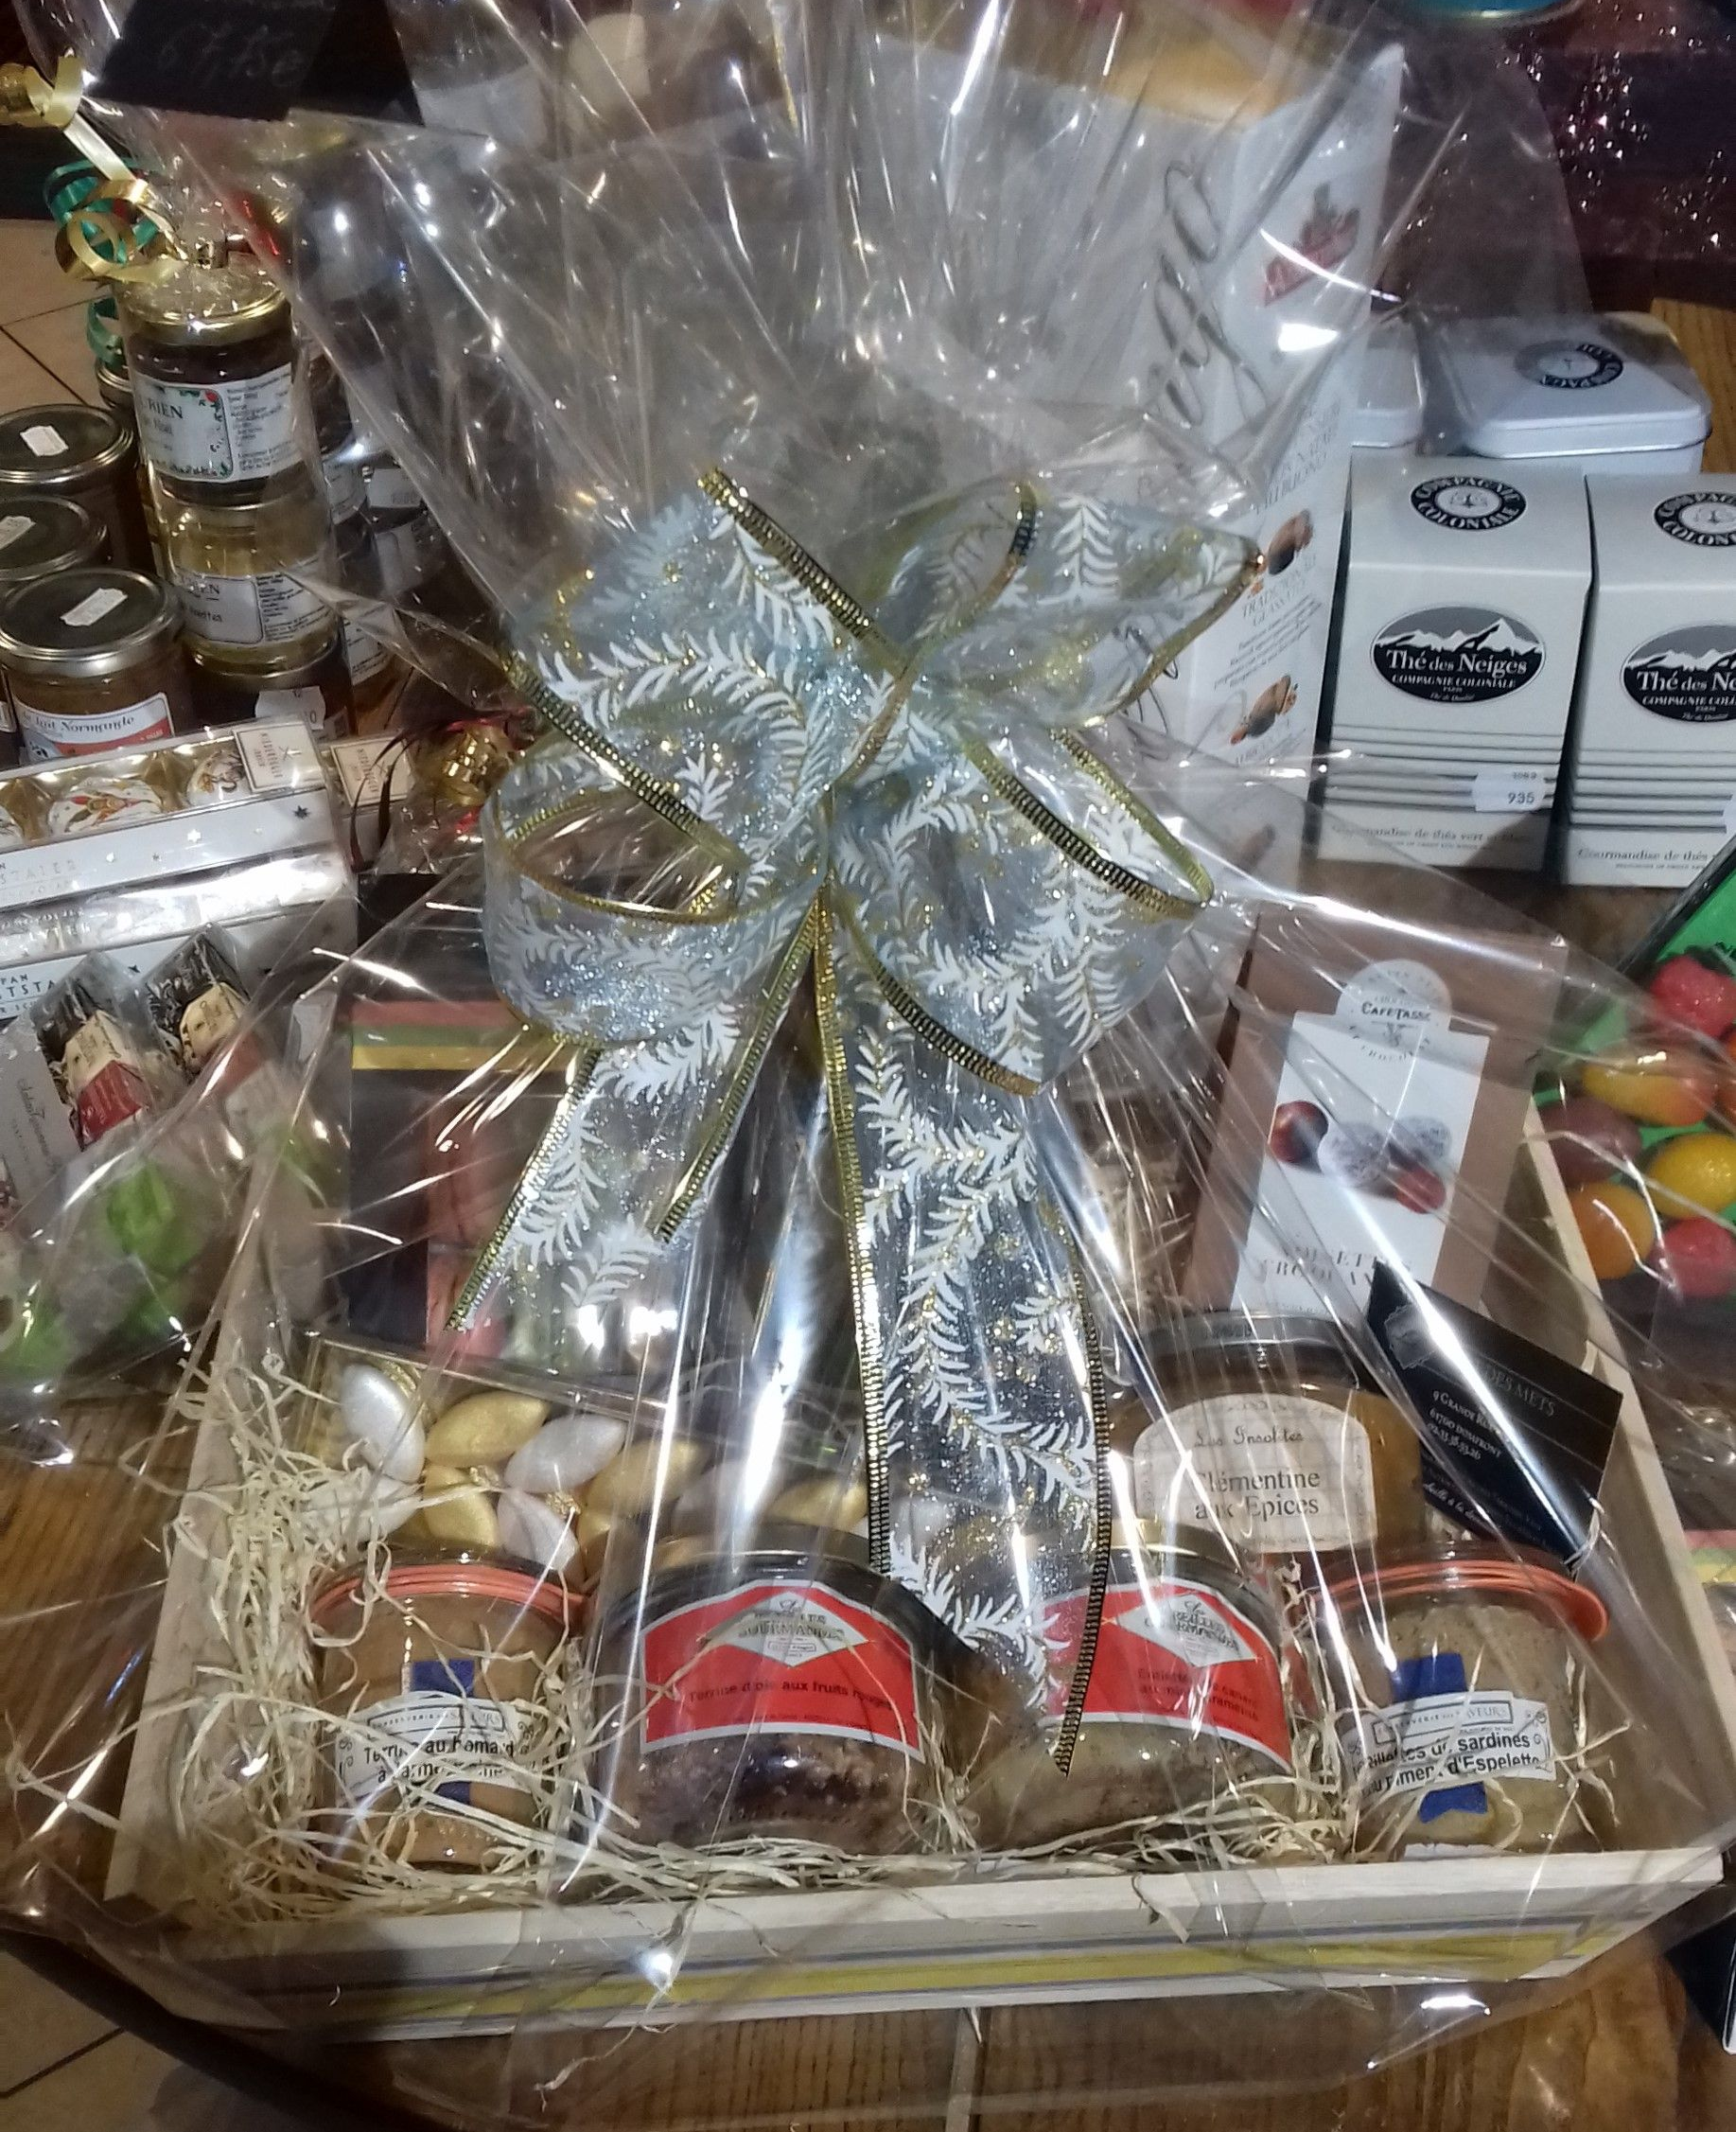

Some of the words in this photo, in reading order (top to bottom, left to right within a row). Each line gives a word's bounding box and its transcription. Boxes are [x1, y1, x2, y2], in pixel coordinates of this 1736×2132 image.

[1386, 649, 1428, 670] Thé
[1429, 656, 1455, 672] des
[1457, 652, 1528, 679] Neiges
[1392, 673, 1456, 687] COMPAGNIE
[1456, 677, 1517, 690] COLONIALE
[1636, 669, 1679, 692] Thé
[1680, 676, 1708, 692] des
[781, 1681, 809, 1694] aux
[812, 1681, 849, 1696] fruits
[427, 1742, 447, 1754] au
[1458, 1731, 1532, 1753] sardines
